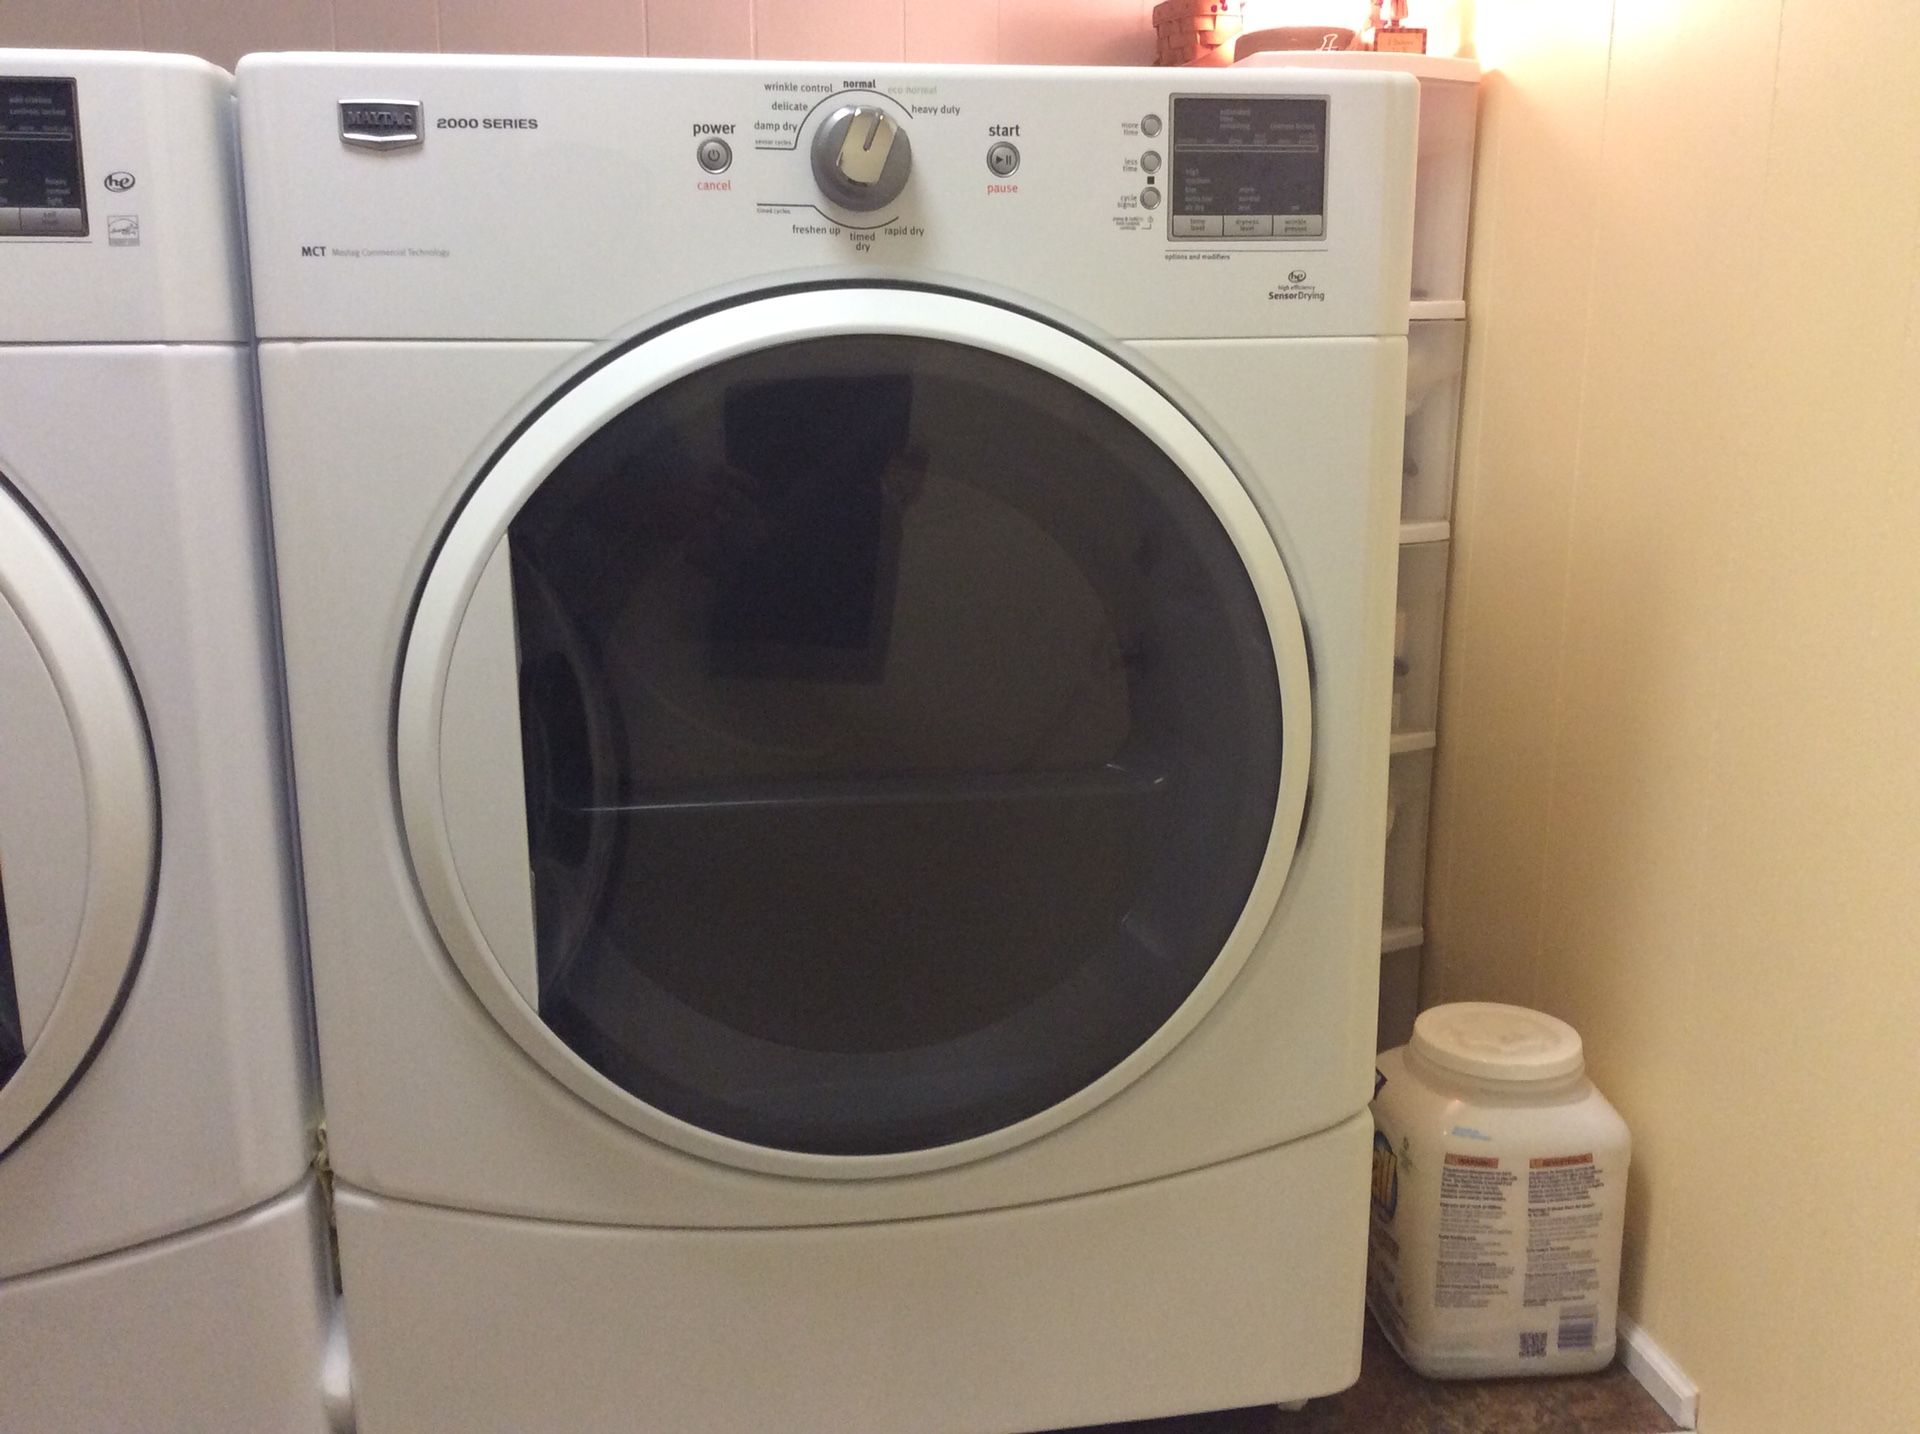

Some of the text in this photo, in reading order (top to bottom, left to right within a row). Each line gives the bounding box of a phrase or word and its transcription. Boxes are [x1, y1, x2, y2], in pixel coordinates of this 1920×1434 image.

[764, 82, 833, 93] wrinkle control
[843, 79, 876, 89] normal
[888, 86, 937, 95] eco normal
[771, 101, 808, 111] delicate
[911, 105, 960, 116] heavy duty
[347, 111, 413, 126] MAYTAG
[436, 118, 538, 129] 2000 SERIES
[693, 123, 736, 136] power
[754, 120, 798, 133] damp dry
[988, 124, 1020, 136] start
[106, 173, 132, 190] he
[697, 180, 731, 191] cancel
[987, 184, 1018, 195] pause
[792, 224, 841, 236] freshen up
[884, 226, 925, 237] rapid dry
[850, 231, 875, 241] timed
[301, 246, 326, 257] MCT
[855, 242, 870, 252] dry
[1268, 291, 1325, 301] SensorDrying
